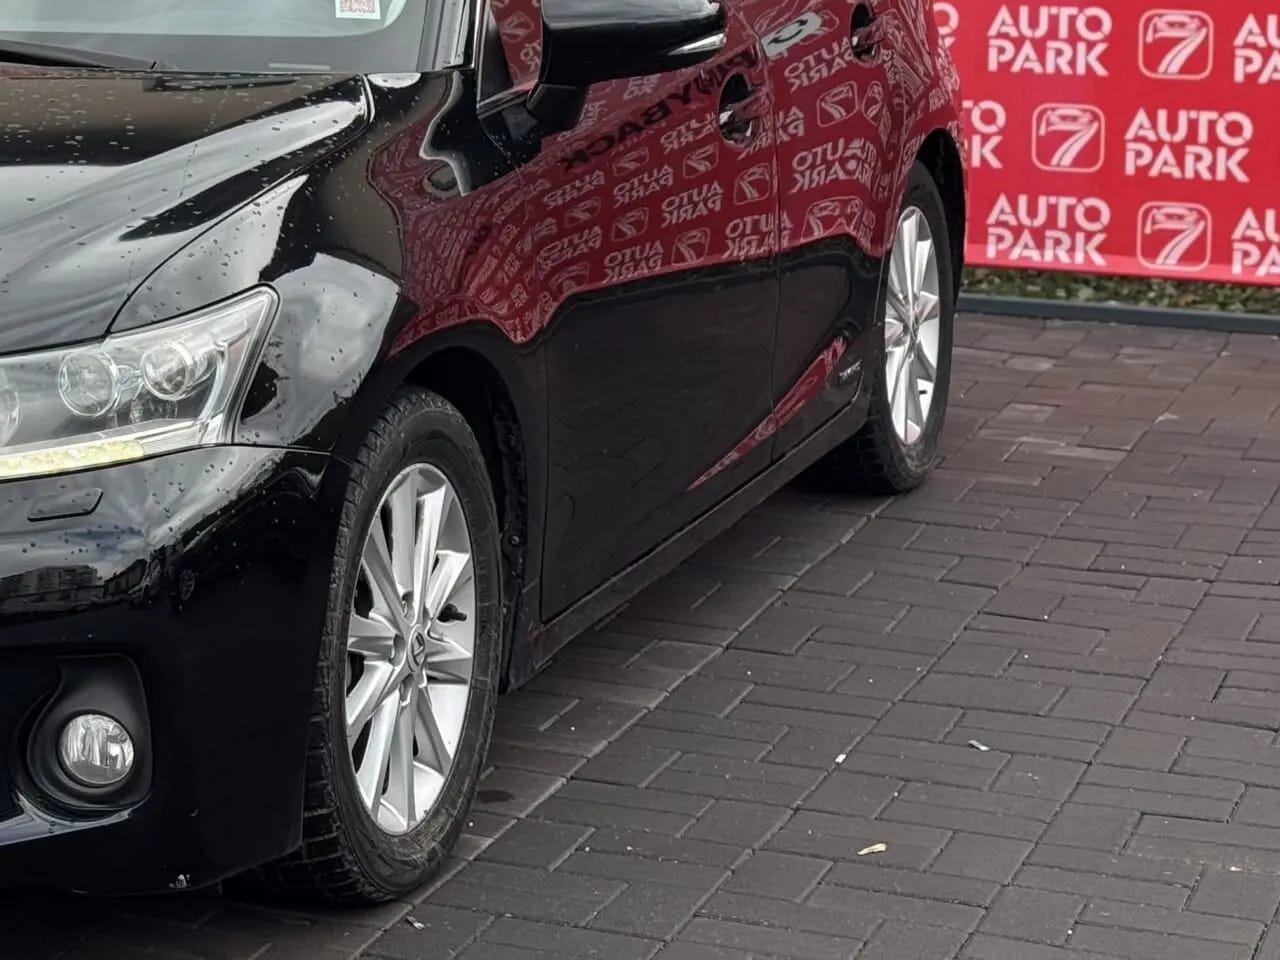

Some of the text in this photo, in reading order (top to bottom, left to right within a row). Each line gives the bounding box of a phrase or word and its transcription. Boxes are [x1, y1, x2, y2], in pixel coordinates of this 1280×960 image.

[987, 5, 1112, 41] AUTO
[988, 37, 1108, 76] PARK
[1124, 108, 1253, 147] AUTO
[1125, 141, 1249, 182] PARK
[986, 193, 1111, 231] AUTO
[986, 228, 1108, 267] PARK
